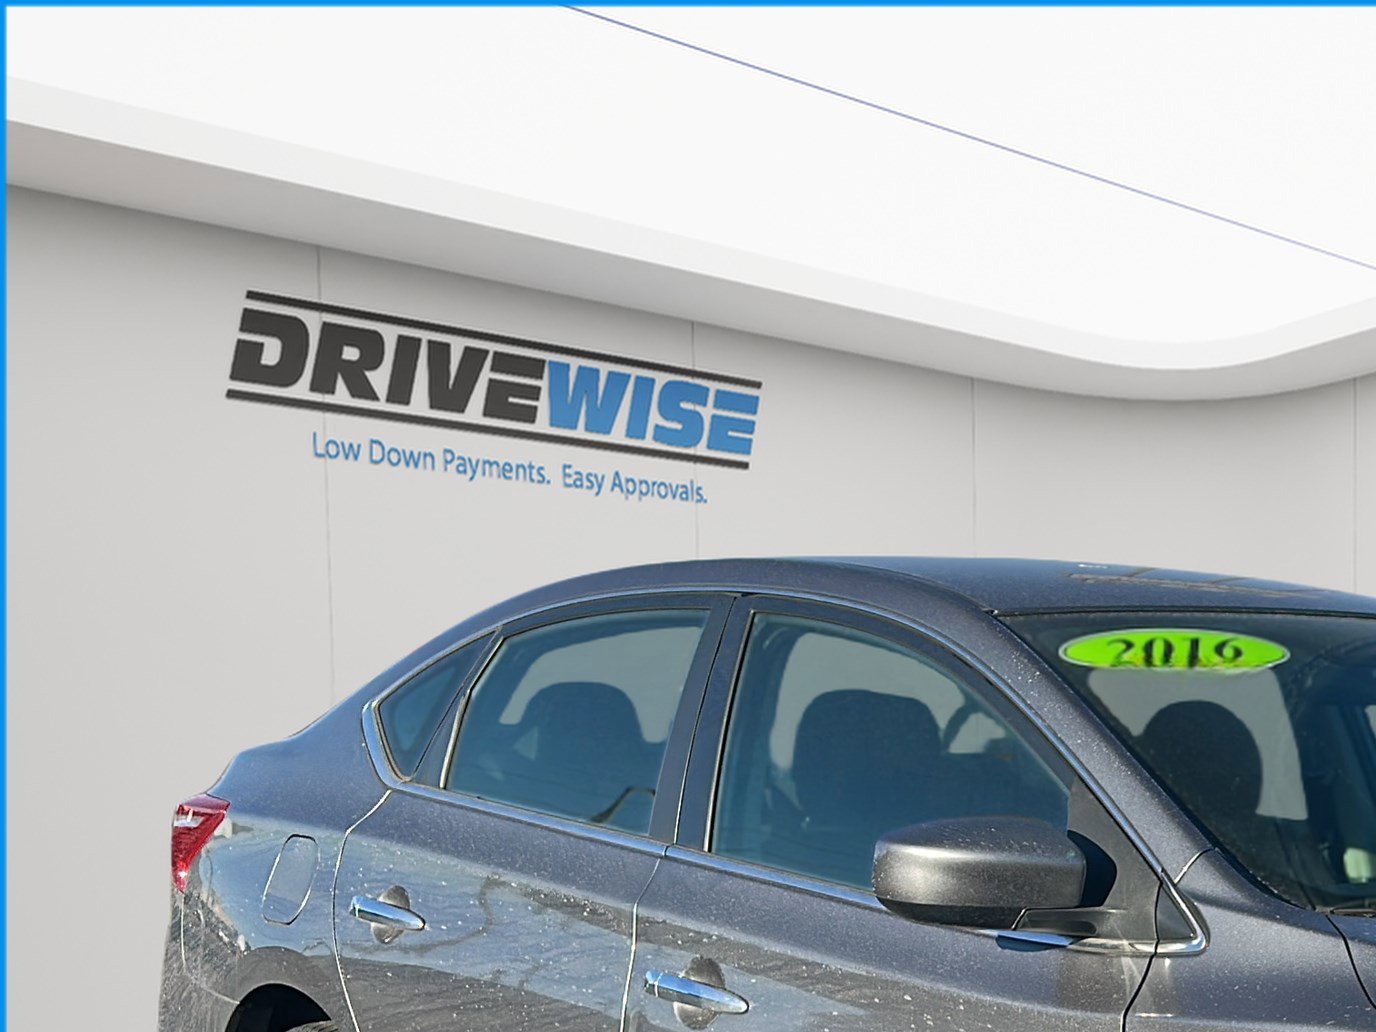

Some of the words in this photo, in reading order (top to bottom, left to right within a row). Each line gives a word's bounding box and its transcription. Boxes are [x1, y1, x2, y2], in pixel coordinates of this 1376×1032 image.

[229, 307, 760, 455] DRIVEWISE
[313, 432, 363, 463] Low
[369, 438, 435, 471] Down
[443, 448, 551, 488] Payments.
[562, 464, 606, 497] Easy
[611, 470, 708, 504] Approvals.
[1107, 638, 1243, 668] 2016
